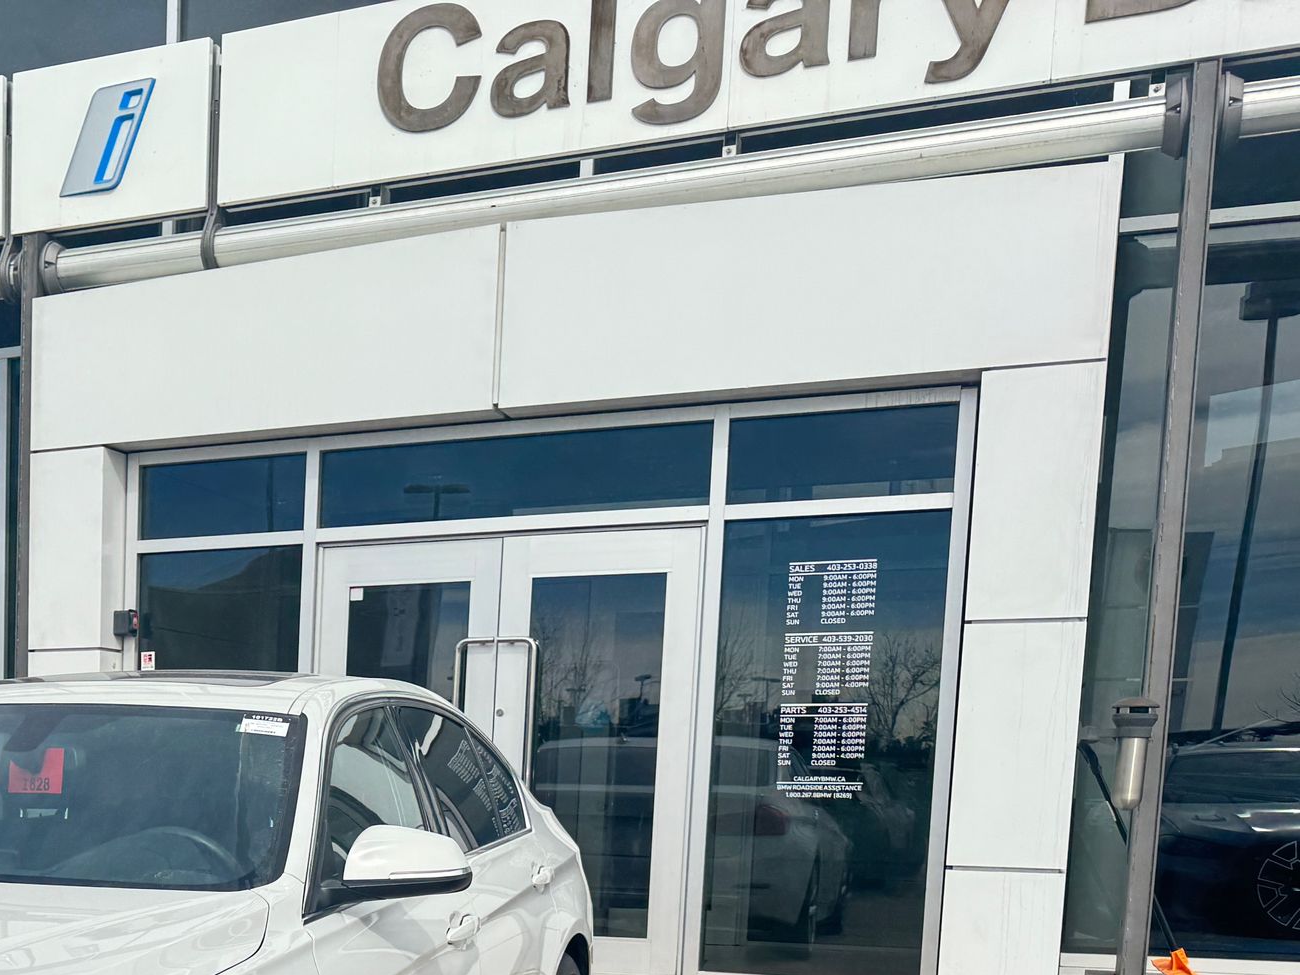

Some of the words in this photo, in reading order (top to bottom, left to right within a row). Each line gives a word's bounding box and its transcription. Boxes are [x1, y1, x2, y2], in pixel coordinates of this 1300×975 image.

[789, 564, 815, 573] SALES
[827, 563, 877, 571] 403-253-0338
[785, 636, 818, 644] SERVICE
[780, 706, 807, 714] PARTS
[818, 706, 867, 714] 403-253-4514
